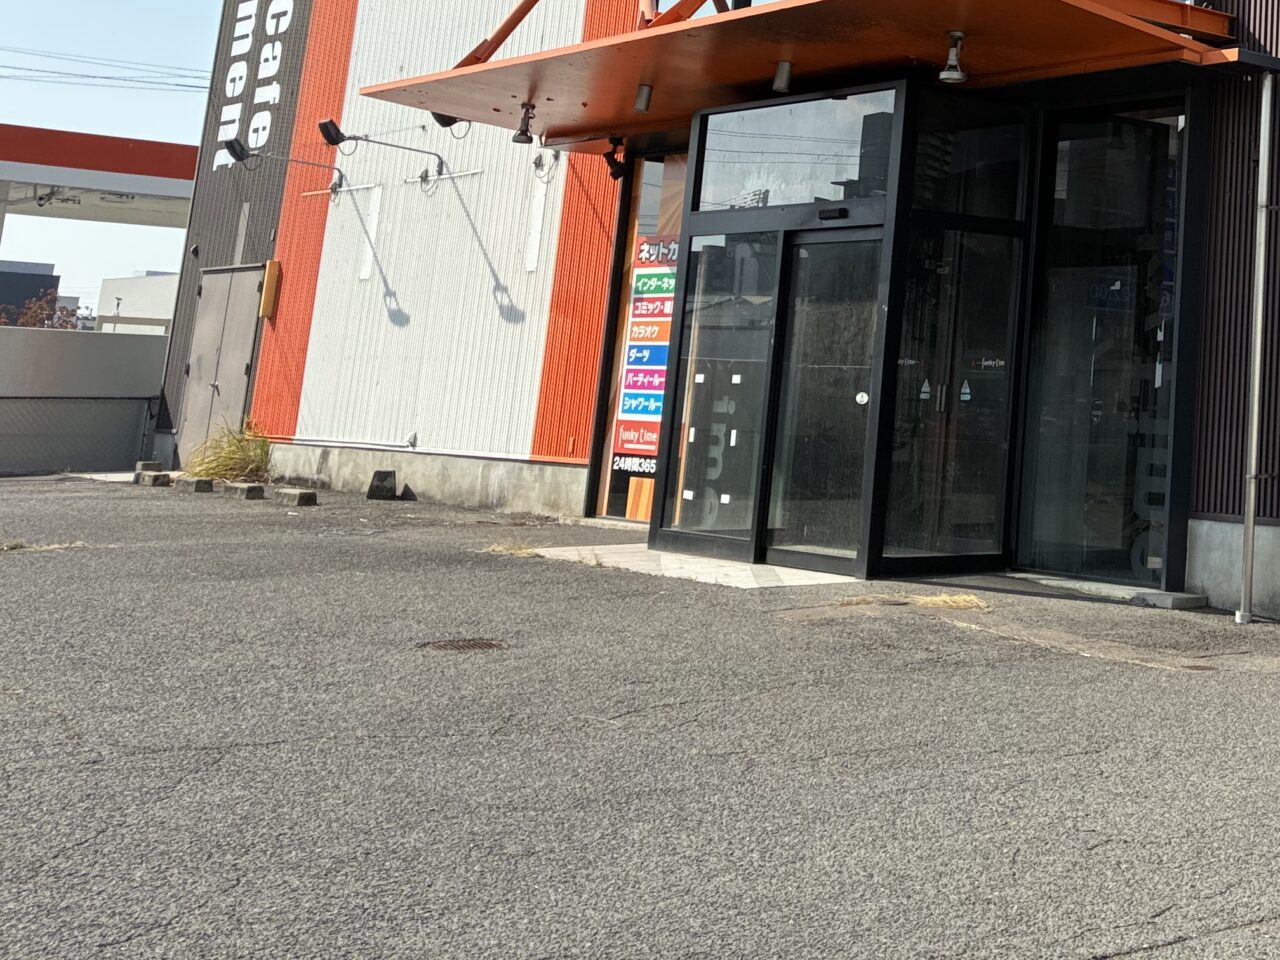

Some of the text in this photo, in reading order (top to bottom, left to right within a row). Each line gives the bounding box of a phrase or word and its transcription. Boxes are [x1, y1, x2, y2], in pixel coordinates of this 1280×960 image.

[638, 240, 679, 263] ネットカ
[631, 324, 660, 339] カラオケ
[629, 347, 651, 363] ダーツ
[618, 424, 658, 448] funky time
